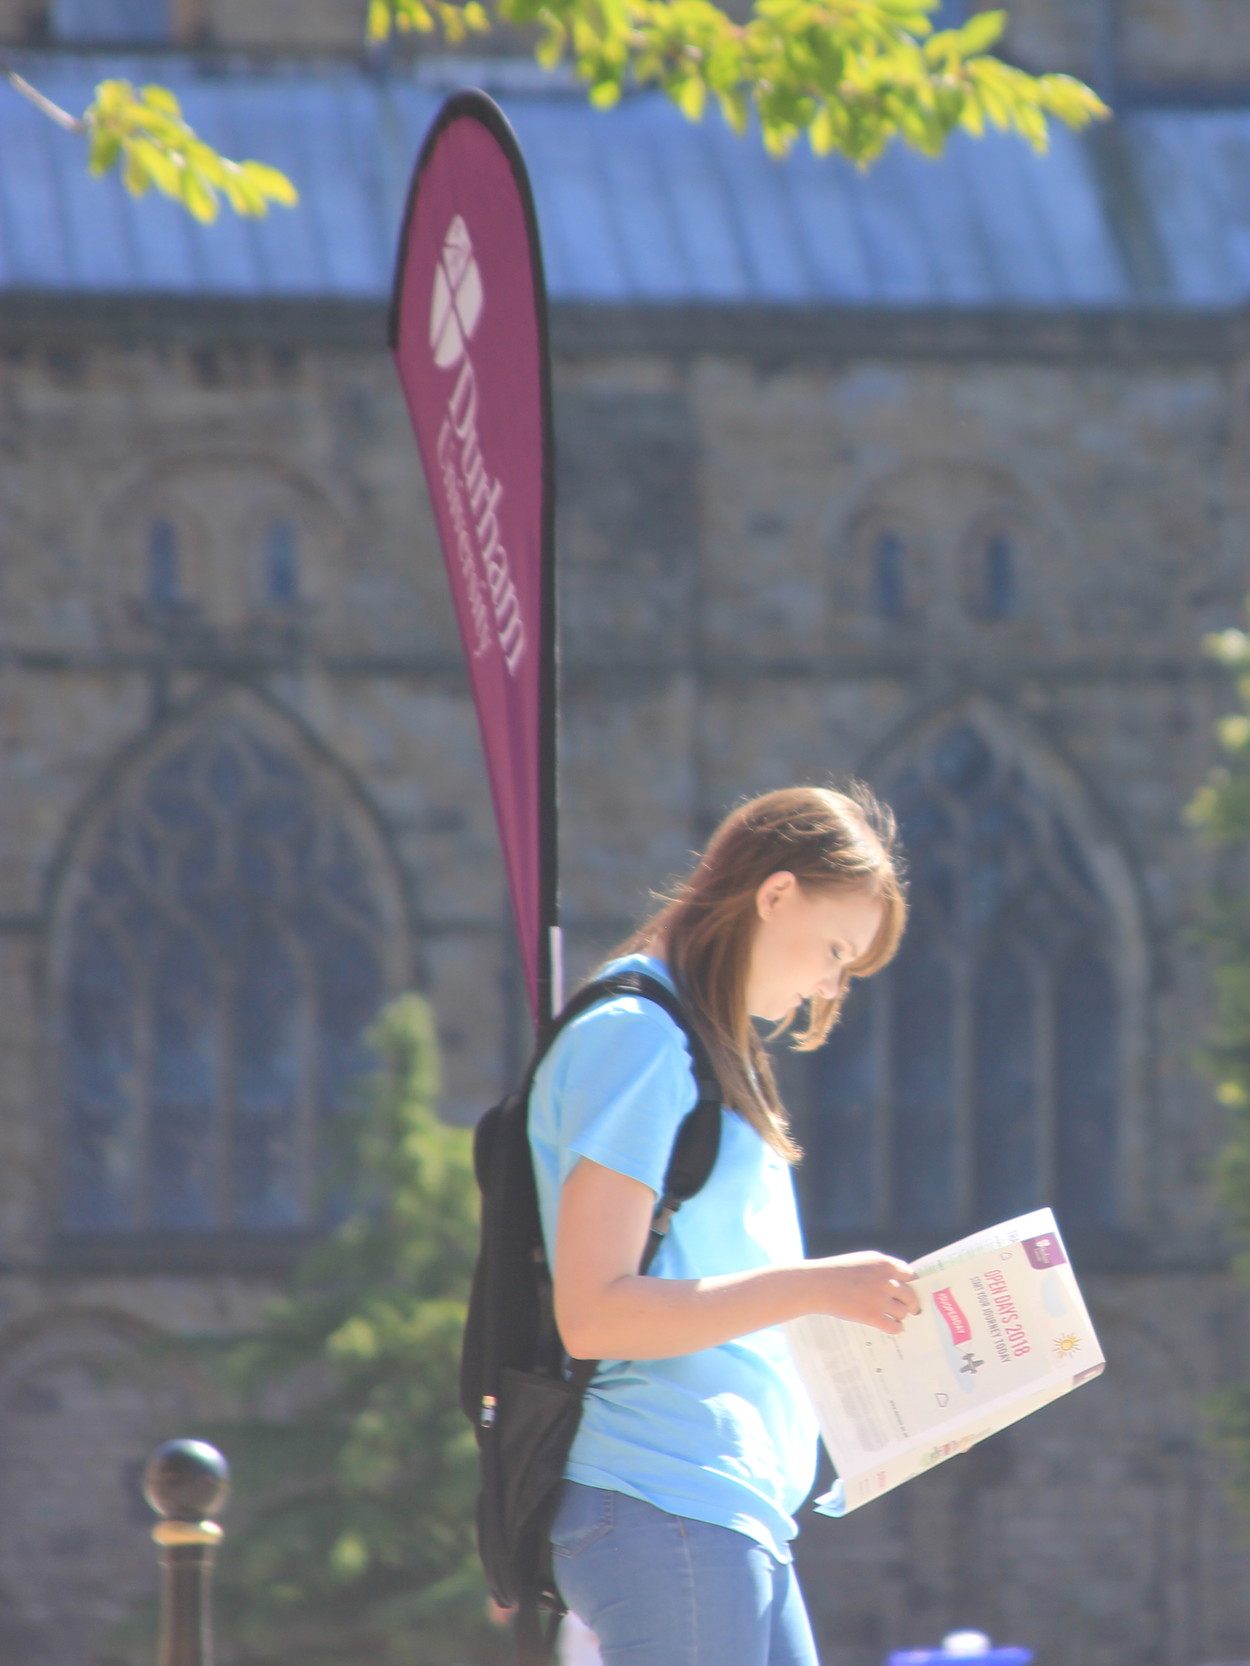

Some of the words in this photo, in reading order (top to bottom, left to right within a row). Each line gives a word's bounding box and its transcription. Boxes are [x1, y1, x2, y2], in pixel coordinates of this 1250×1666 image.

[450, 352, 524, 676] Durham
[969, 1275, 984, 1291] START
[983, 1269, 1008, 1295] OPEN
[976, 1291, 990, 1308] YOUR
[994, 1295, 1018, 1324] DAYS
[982, 1307, 1002, 1338] JOURNEY
[994, 1338, 1011, 1363] TODAY
[1005, 1323, 1031, 1357] 2018
